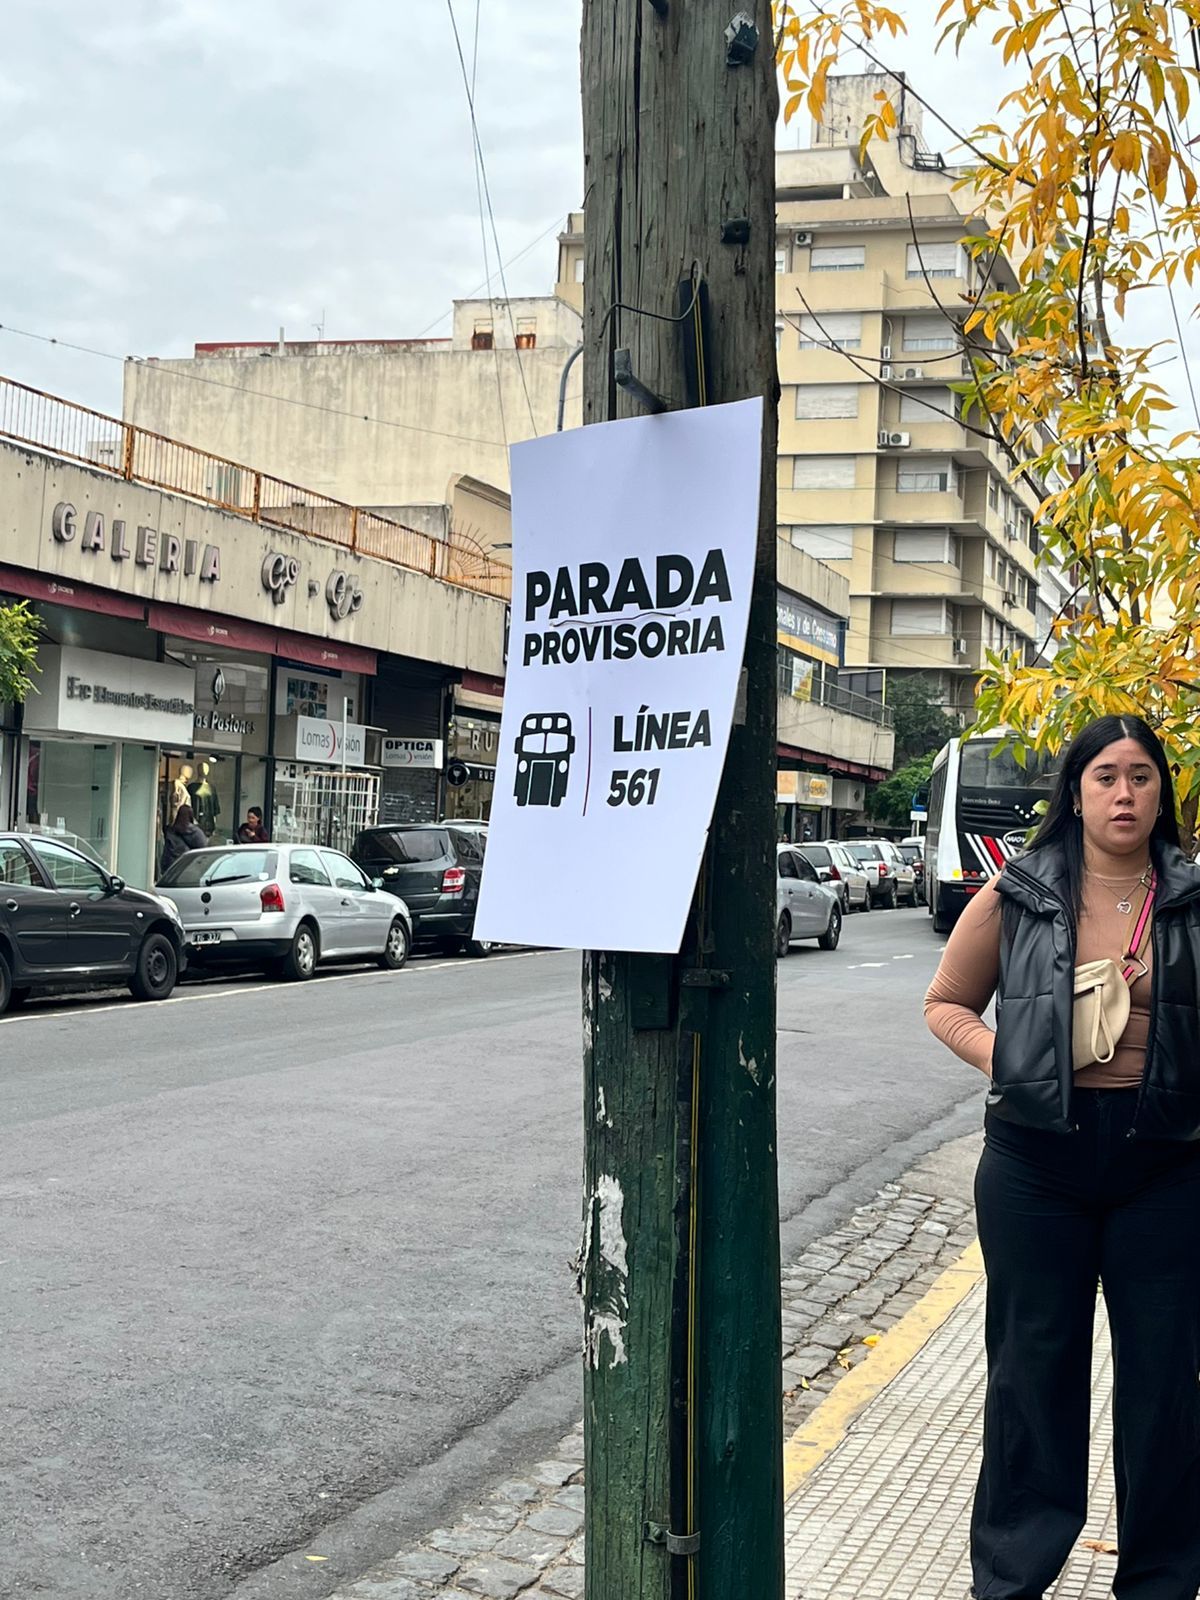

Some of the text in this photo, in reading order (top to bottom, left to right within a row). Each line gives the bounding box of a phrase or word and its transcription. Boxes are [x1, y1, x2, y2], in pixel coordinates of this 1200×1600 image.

[53, 502, 221, 582] GALERIA
[525, 548, 732, 622] PARADA
[523, 615, 725, 666] PROVISORIA
[210, 710, 256, 735] Pasiones
[301, 728, 361, 754] Lomas vsión
[471, 730, 494, 752] RU
[613, 704, 711, 752] LÍNEA
[385, 740, 434, 752] OPTICA
[606, 768, 661, 807] 561
